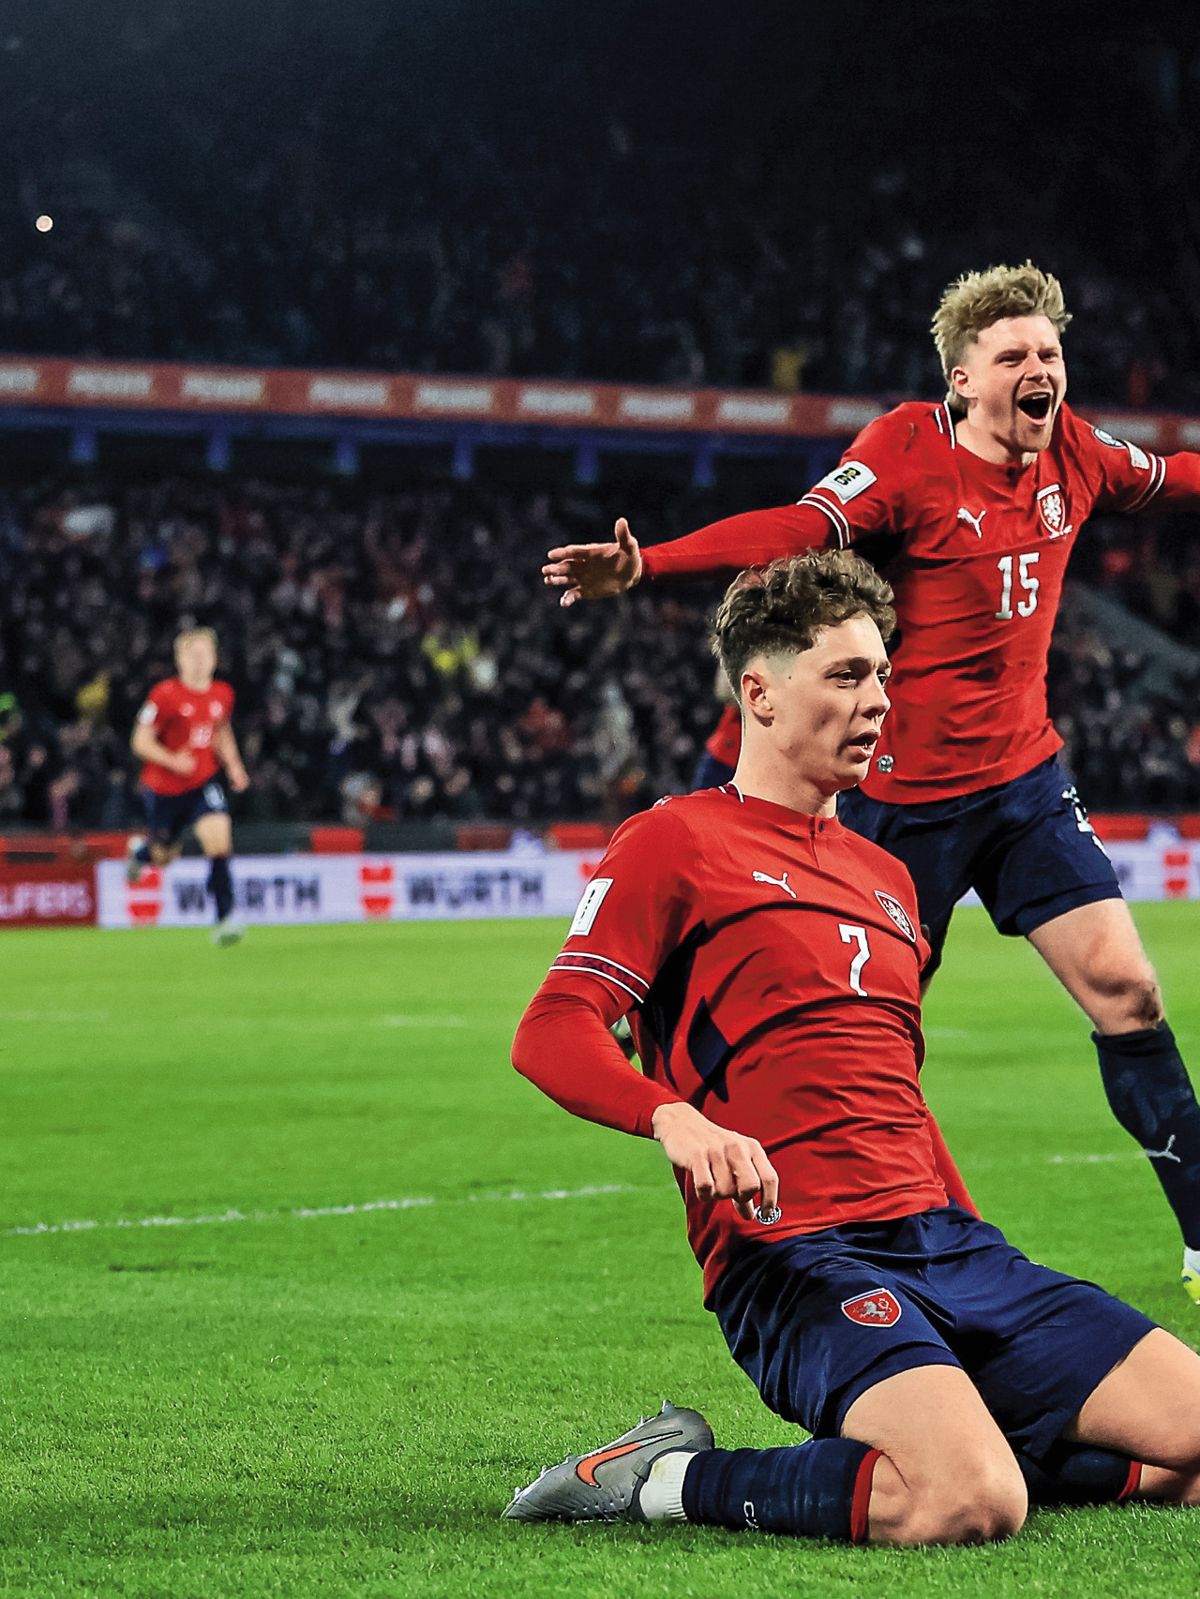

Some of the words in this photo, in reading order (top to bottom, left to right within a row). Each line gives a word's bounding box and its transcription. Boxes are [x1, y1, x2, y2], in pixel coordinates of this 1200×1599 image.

[995, 552, 1040, 619] 15
[174, 874, 321, 914] WRTH
[838, 923, 871, 997] 7
